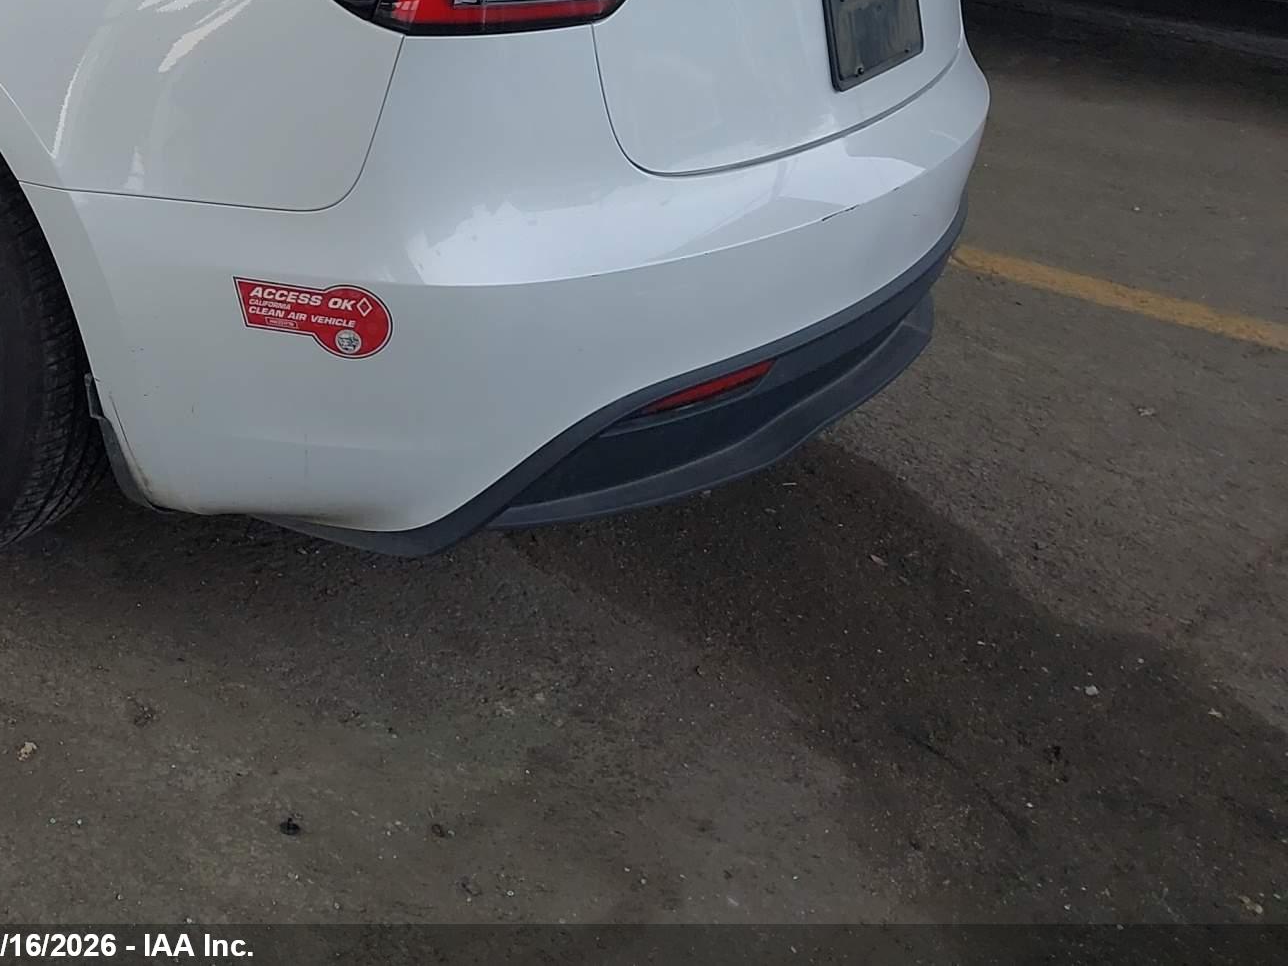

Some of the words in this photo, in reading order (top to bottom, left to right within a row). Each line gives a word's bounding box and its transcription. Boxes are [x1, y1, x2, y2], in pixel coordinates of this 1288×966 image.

[249, 286, 323, 307] ACCESS
[328, 297, 357, 311] OK
[249, 299, 291, 310] CALIFORNIA
[248, 306, 285, 318] CLEAN
[287, 311, 308, 322] AIR
[311, 315, 357, 329] VEHICLE
